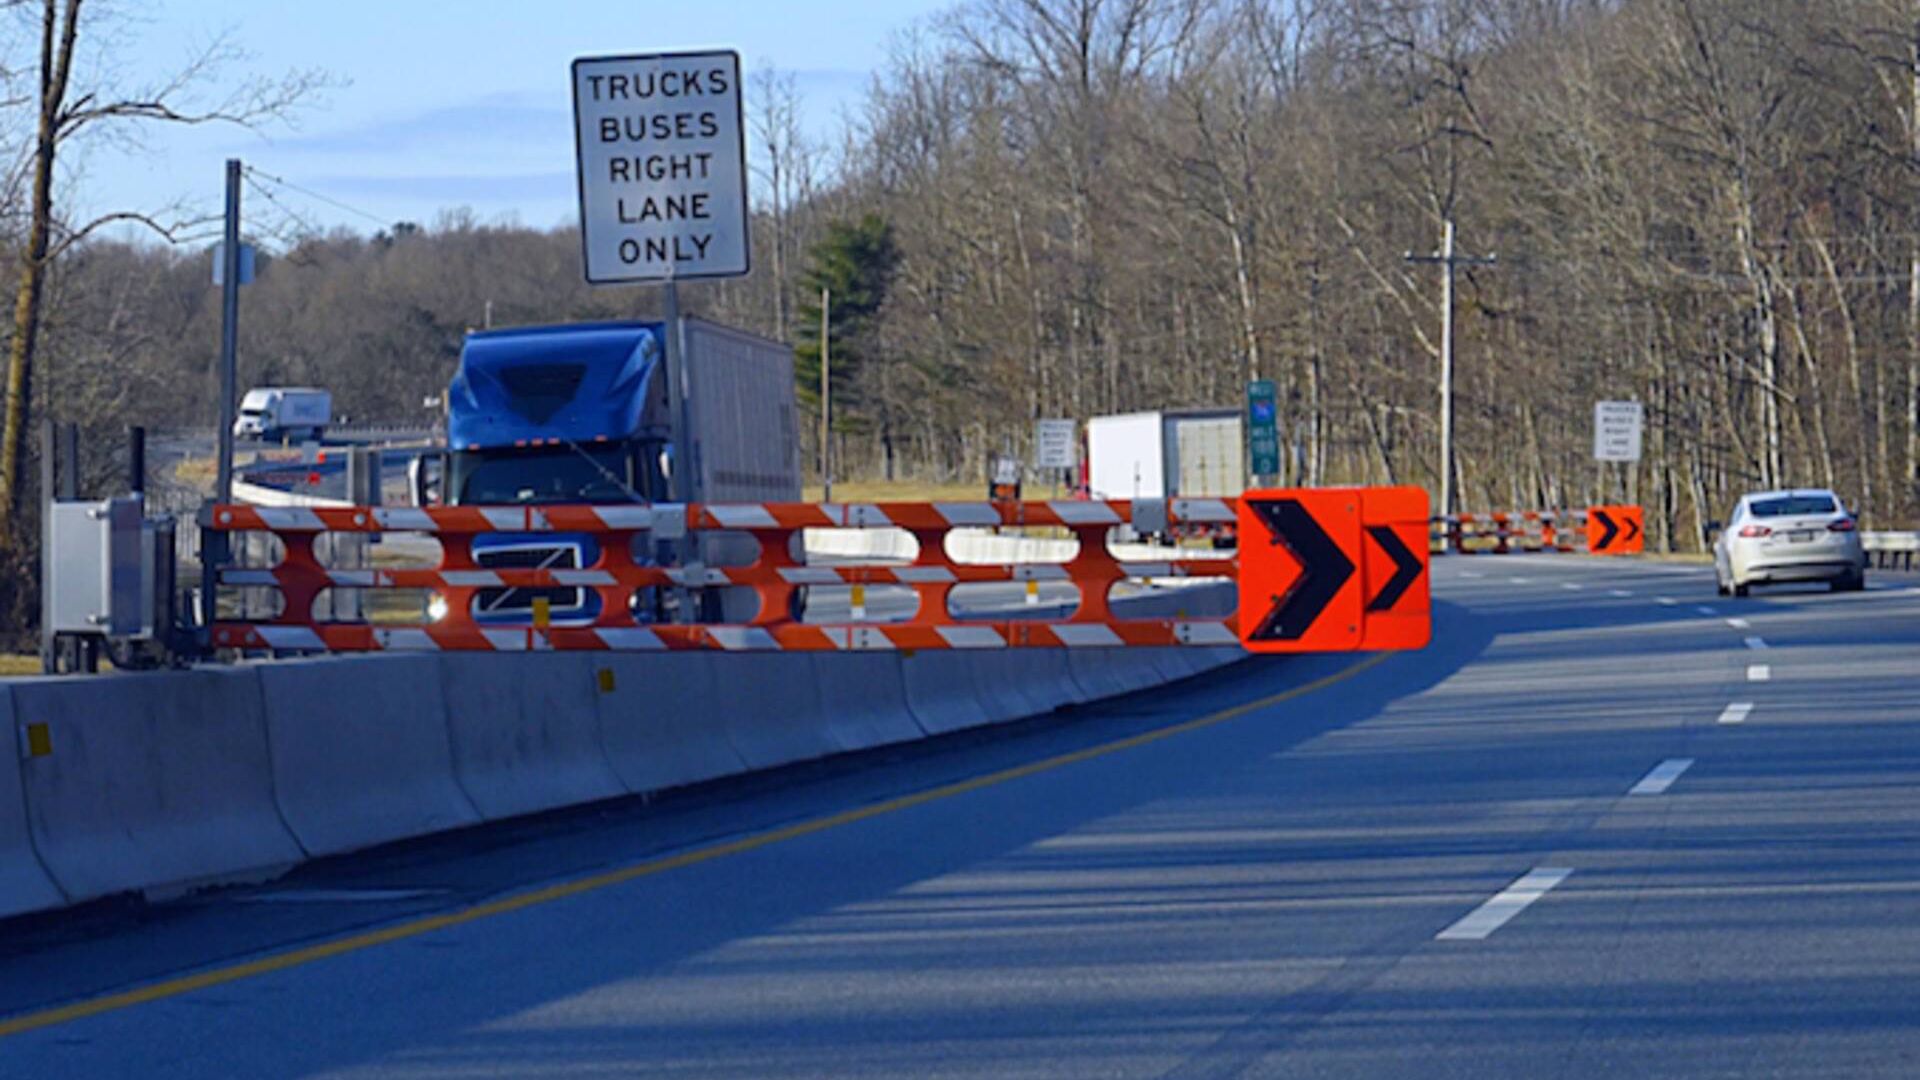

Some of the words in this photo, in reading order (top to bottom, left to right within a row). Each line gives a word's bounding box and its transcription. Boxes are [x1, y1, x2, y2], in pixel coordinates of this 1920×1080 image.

[587, 69, 728, 100] TRUCKS
[600, 111, 719, 143] BUSES
[609, 153, 711, 182] RIGHT
[618, 193, 710, 224] LANE
[619, 234, 712, 264] ONLY
